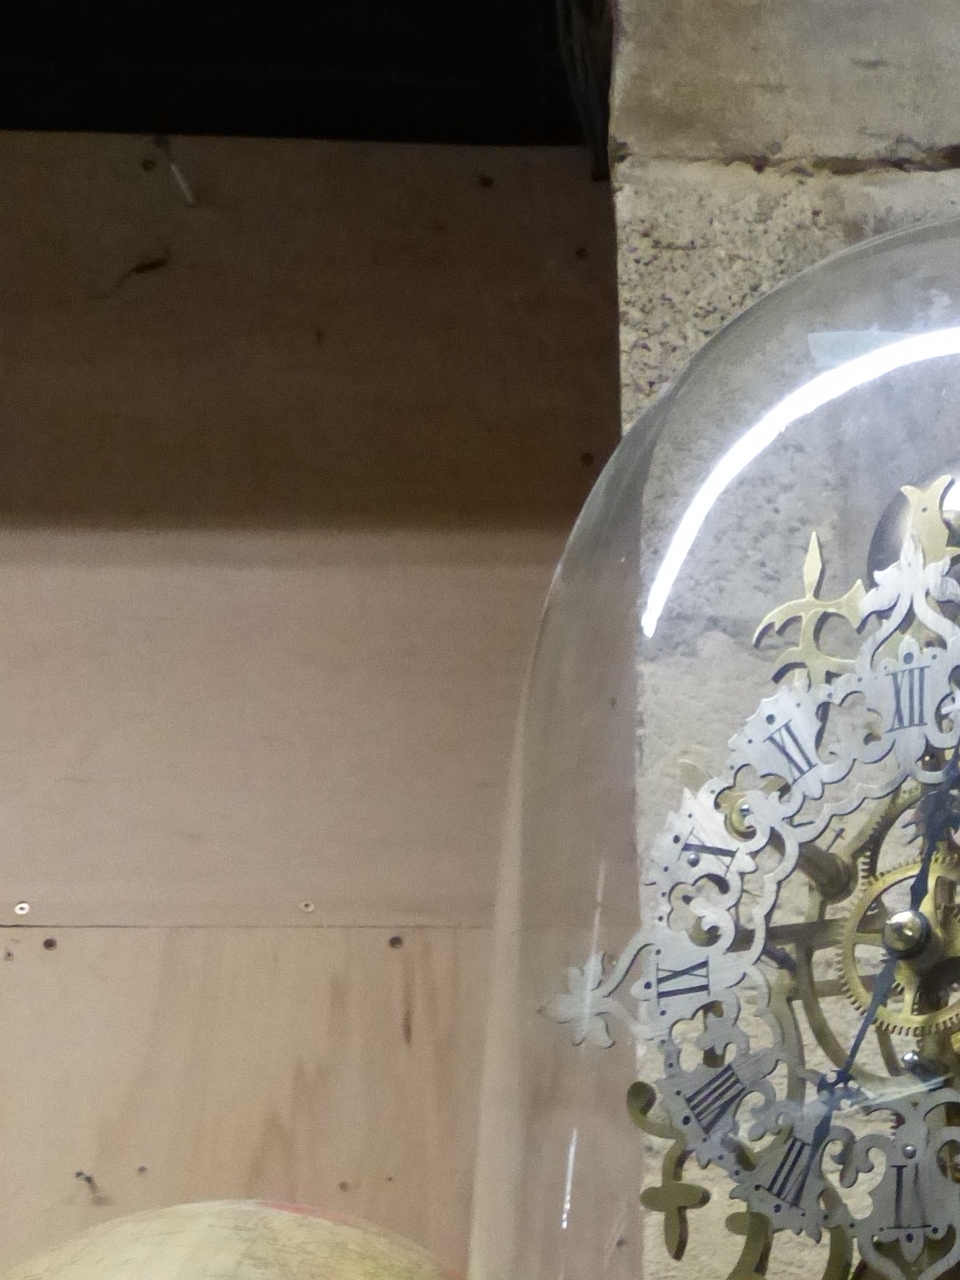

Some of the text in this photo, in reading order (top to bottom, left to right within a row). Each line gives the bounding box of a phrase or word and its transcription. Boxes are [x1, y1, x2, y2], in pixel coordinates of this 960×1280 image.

[884, 665, 931, 734] XII
[763, 719, 818, 786] XI
[677, 826, 740, 878] X
[656, 955, 710, 1007] IX
[683, 1063, 747, 1135] VIII
